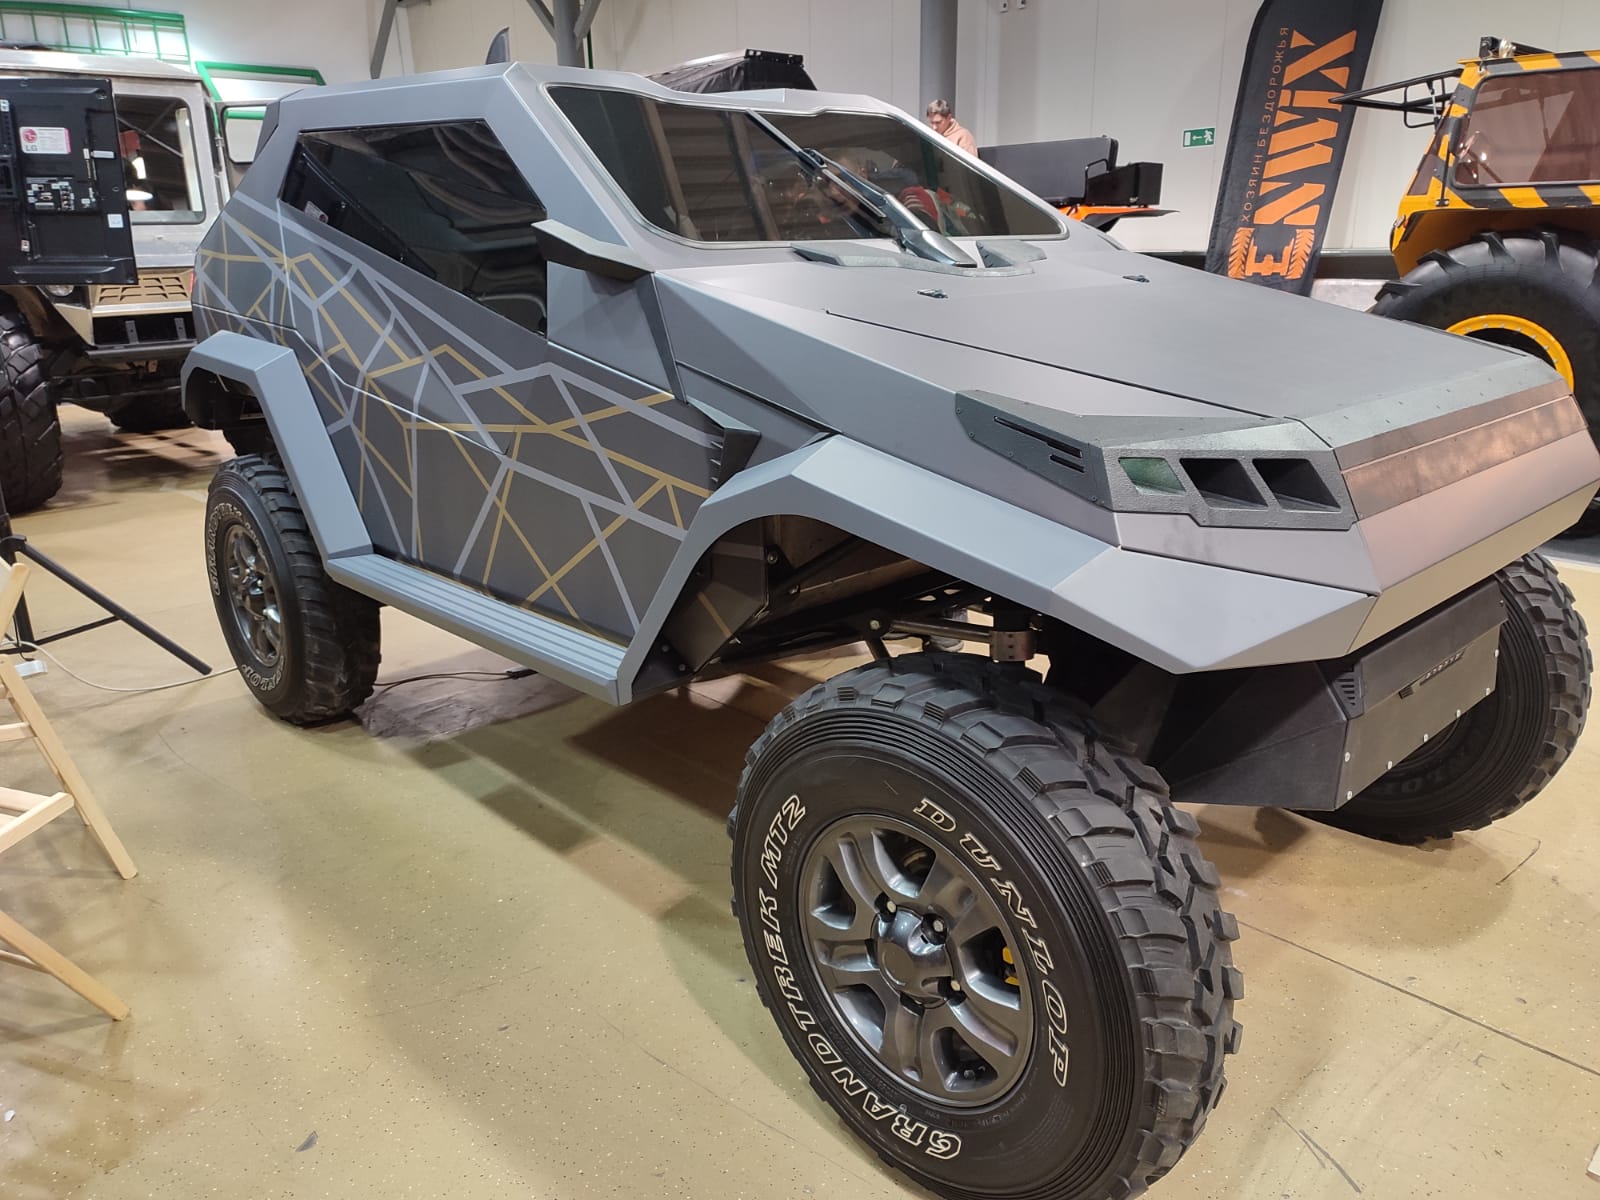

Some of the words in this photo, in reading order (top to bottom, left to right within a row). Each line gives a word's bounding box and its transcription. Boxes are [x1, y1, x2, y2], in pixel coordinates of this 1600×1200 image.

[25, 144, 38, 152] LG
[1240, 154, 1264, 223] ХОЗЯИН
[1256, 27, 1289, 147] БЕЗДОРОЖЬЯ
[759, 794, 806, 890] MT2
[758, 887, 962, 1160] GRANDTREK
[912, 798, 1070, 1087] DUNLOP
